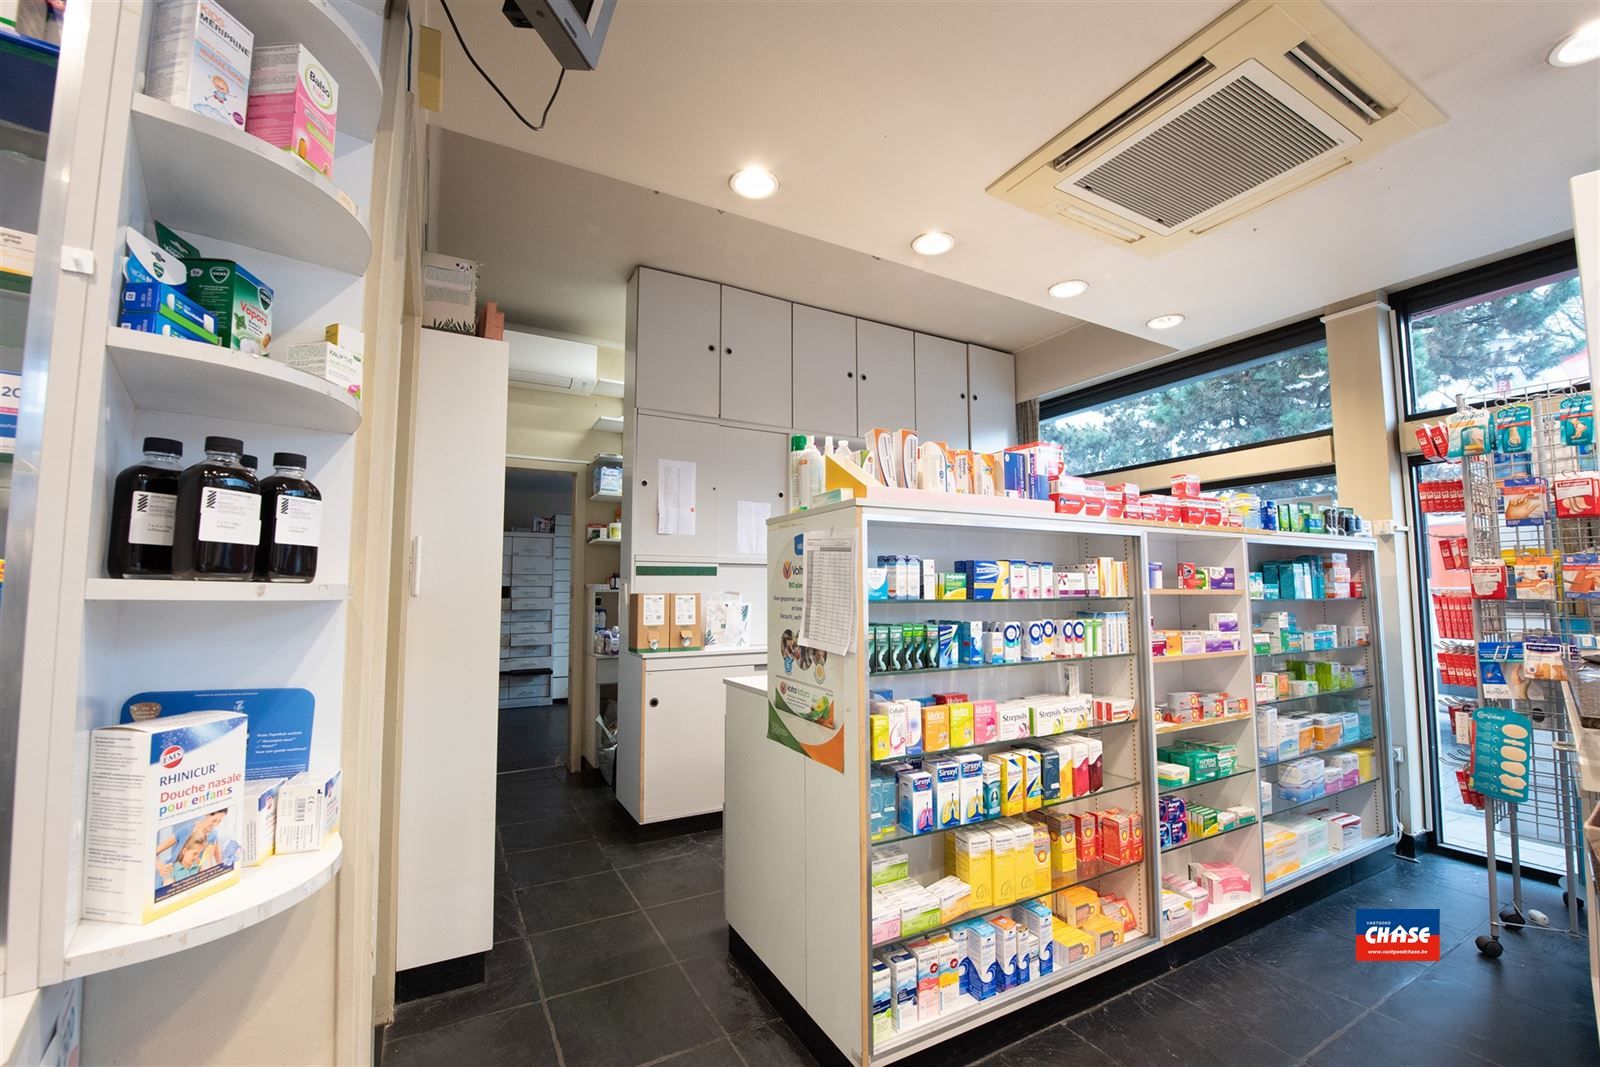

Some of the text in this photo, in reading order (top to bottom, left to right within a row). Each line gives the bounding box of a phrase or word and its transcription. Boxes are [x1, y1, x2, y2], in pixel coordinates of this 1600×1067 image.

[200, 12, 250, 58] MERIPRINE
[309, 70, 330, 98] Balso
[240, 301, 268, 327] Vapors
[1002, 712, 1028, 722] Strepsils
[1038, 709, 1061, 718] Strepsils
[1476, 710, 1505, 721] Compeed
[162, 751, 182, 764] EMS
[963, 761, 981, 770] Siroxyl
[939, 768, 958, 777] Siroxyl
[914, 777, 931, 785] Siroxyl
[159, 773, 242, 804] Douche nasale
[158, 786, 233, 818] pour enfants
